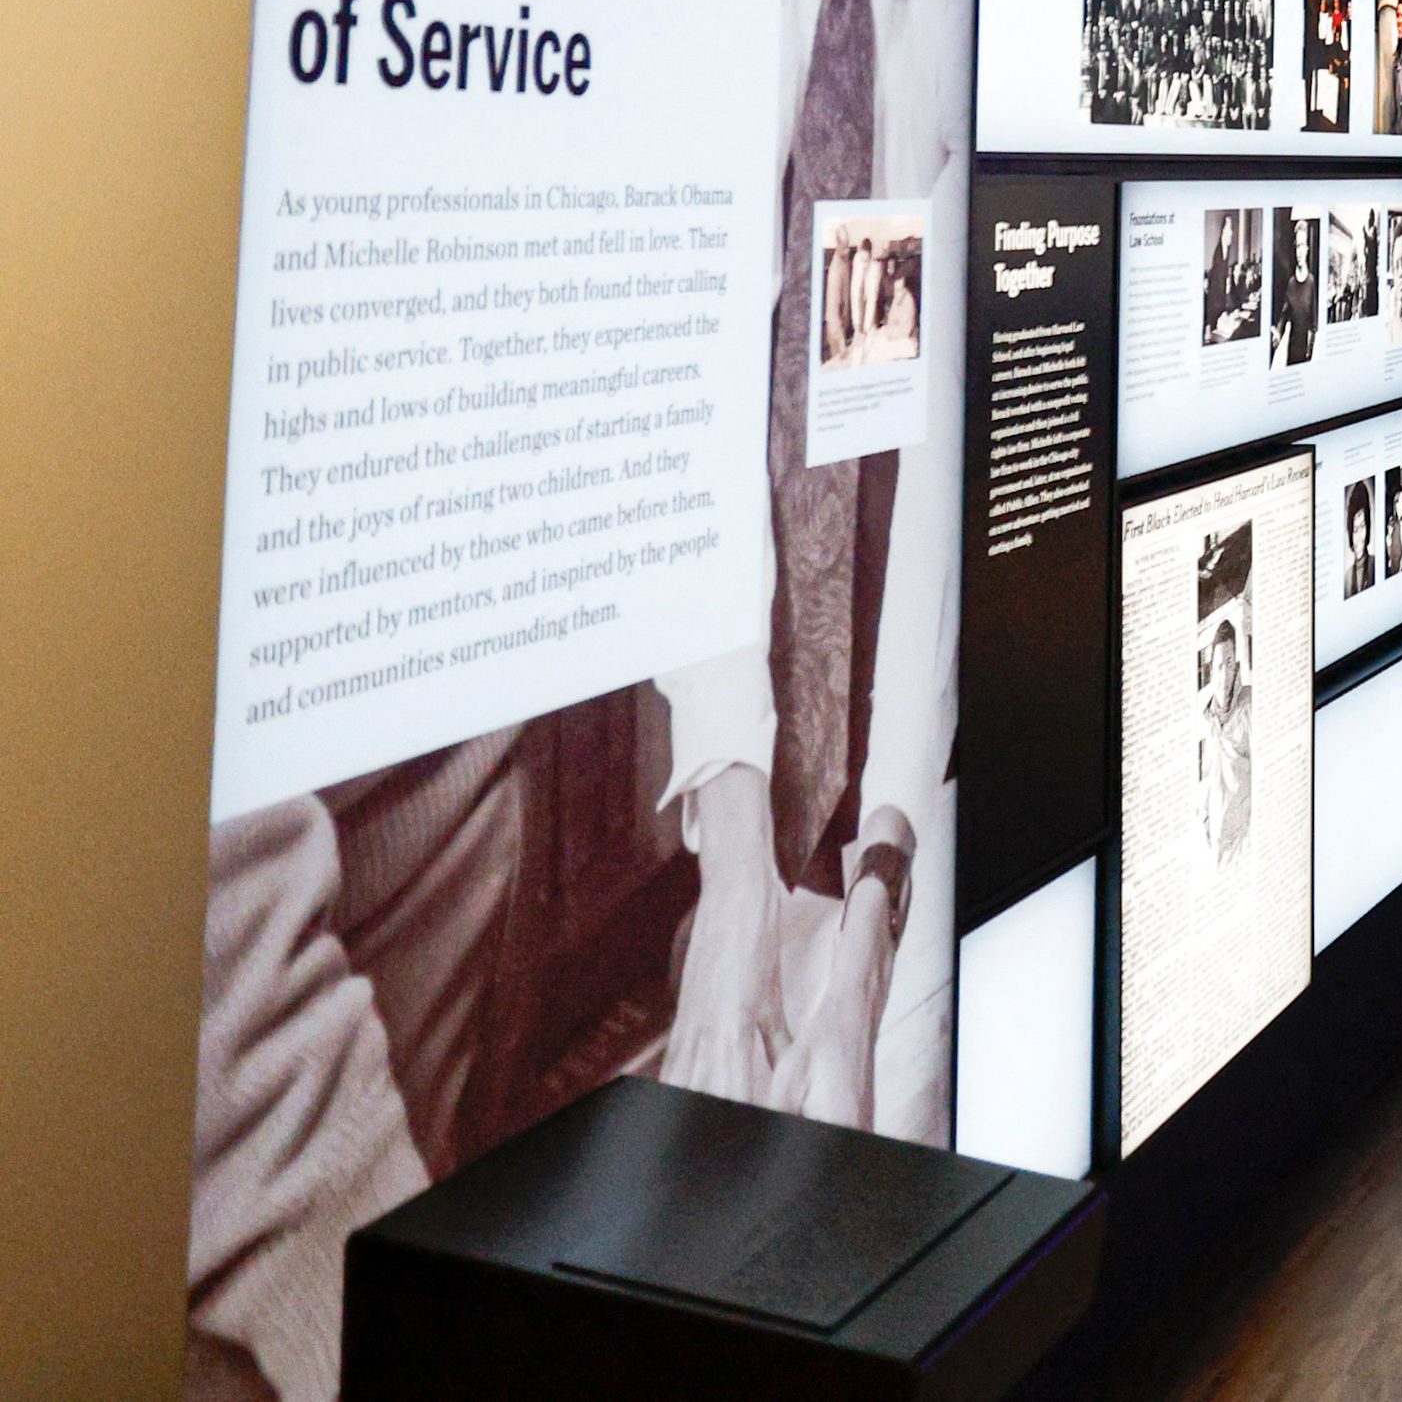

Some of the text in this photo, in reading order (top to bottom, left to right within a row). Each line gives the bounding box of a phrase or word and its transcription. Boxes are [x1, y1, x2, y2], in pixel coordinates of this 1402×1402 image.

[276, 184, 733, 223] As young professionals in Chicago, Barack Obama
[995, 219, 1100, 256] Finding Purpose
[1129, 233, 1164, 248] Law School
[1130, 212, 1167, 226] Foundations
[273, 226, 728, 272] and Michelle Robinson met and fell in love. Their
[994, 260, 1055, 298] Together
[270, 270, 727, 328] lives converged, and they both found their calling
[267, 313, 720, 389] in public service. Together, they experienced the
[264, 363, 702, 444] highs and lows of building meaningful careers.
[260, 398, 715, 497] They endured the challenges of starting a family
[256, 449, 690, 554] and the joys of raising two children. And they
[1123, 518, 1144, 542] First
[1146, 512, 1170, 534] Black
[1174, 498, 1203, 524] Elected
[1204, 500, 1212, 514] to
[1212, 491, 1233, 510] Head
[1270, 472, 1285, 492] Law
[1286, 467, 1310, 485] Review
[252, 490, 715, 609] were influenced by those who came before them,
[249, 527, 720, 668] supported by mentors, and inspired by the people
[244, 603, 620, 726] and communities surrounding them.
